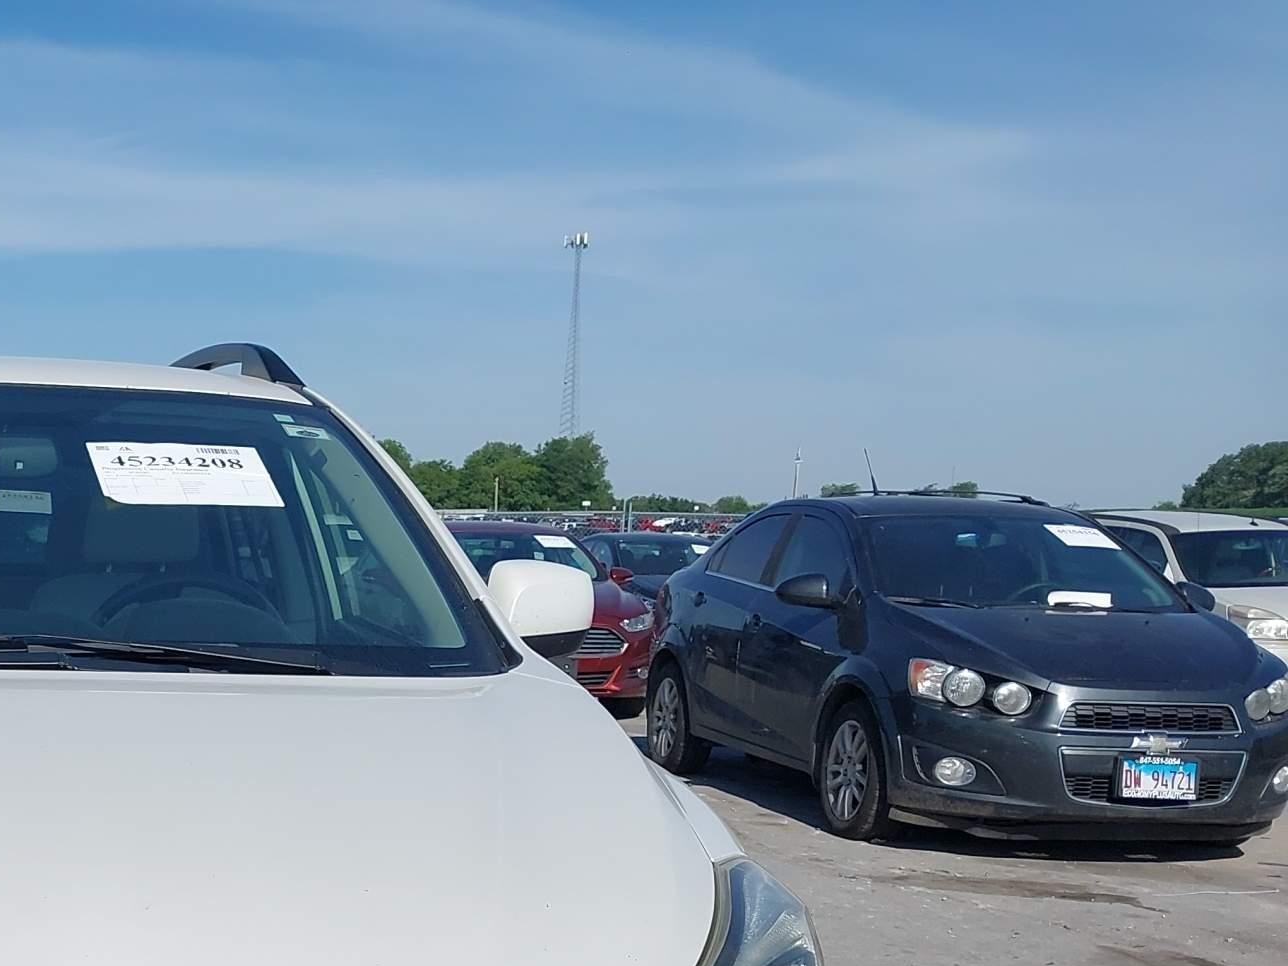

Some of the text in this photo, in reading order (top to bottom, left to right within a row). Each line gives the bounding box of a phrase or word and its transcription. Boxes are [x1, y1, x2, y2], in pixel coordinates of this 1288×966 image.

[109, 455, 244, 470] 45234208
[1123, 769, 1194, 791] DW 94721
